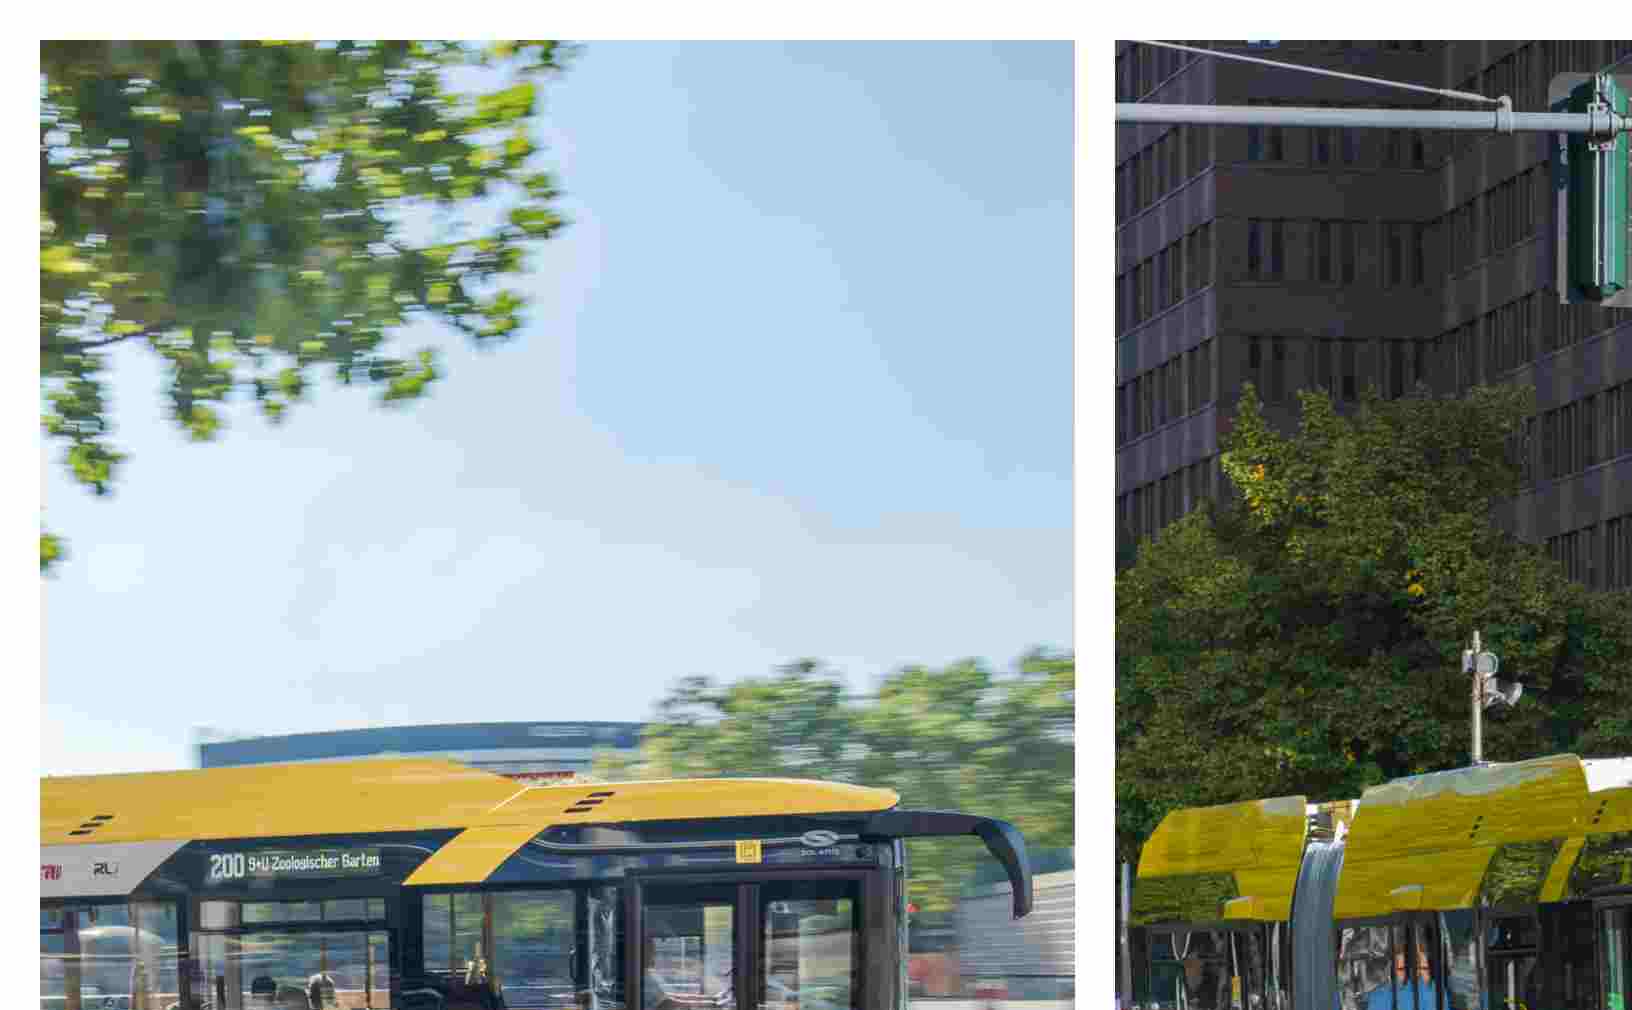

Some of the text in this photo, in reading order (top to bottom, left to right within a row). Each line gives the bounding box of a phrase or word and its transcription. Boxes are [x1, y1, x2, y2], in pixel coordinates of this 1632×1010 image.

[209, 852, 381, 879] 200 S+U Zoologischer Garten
